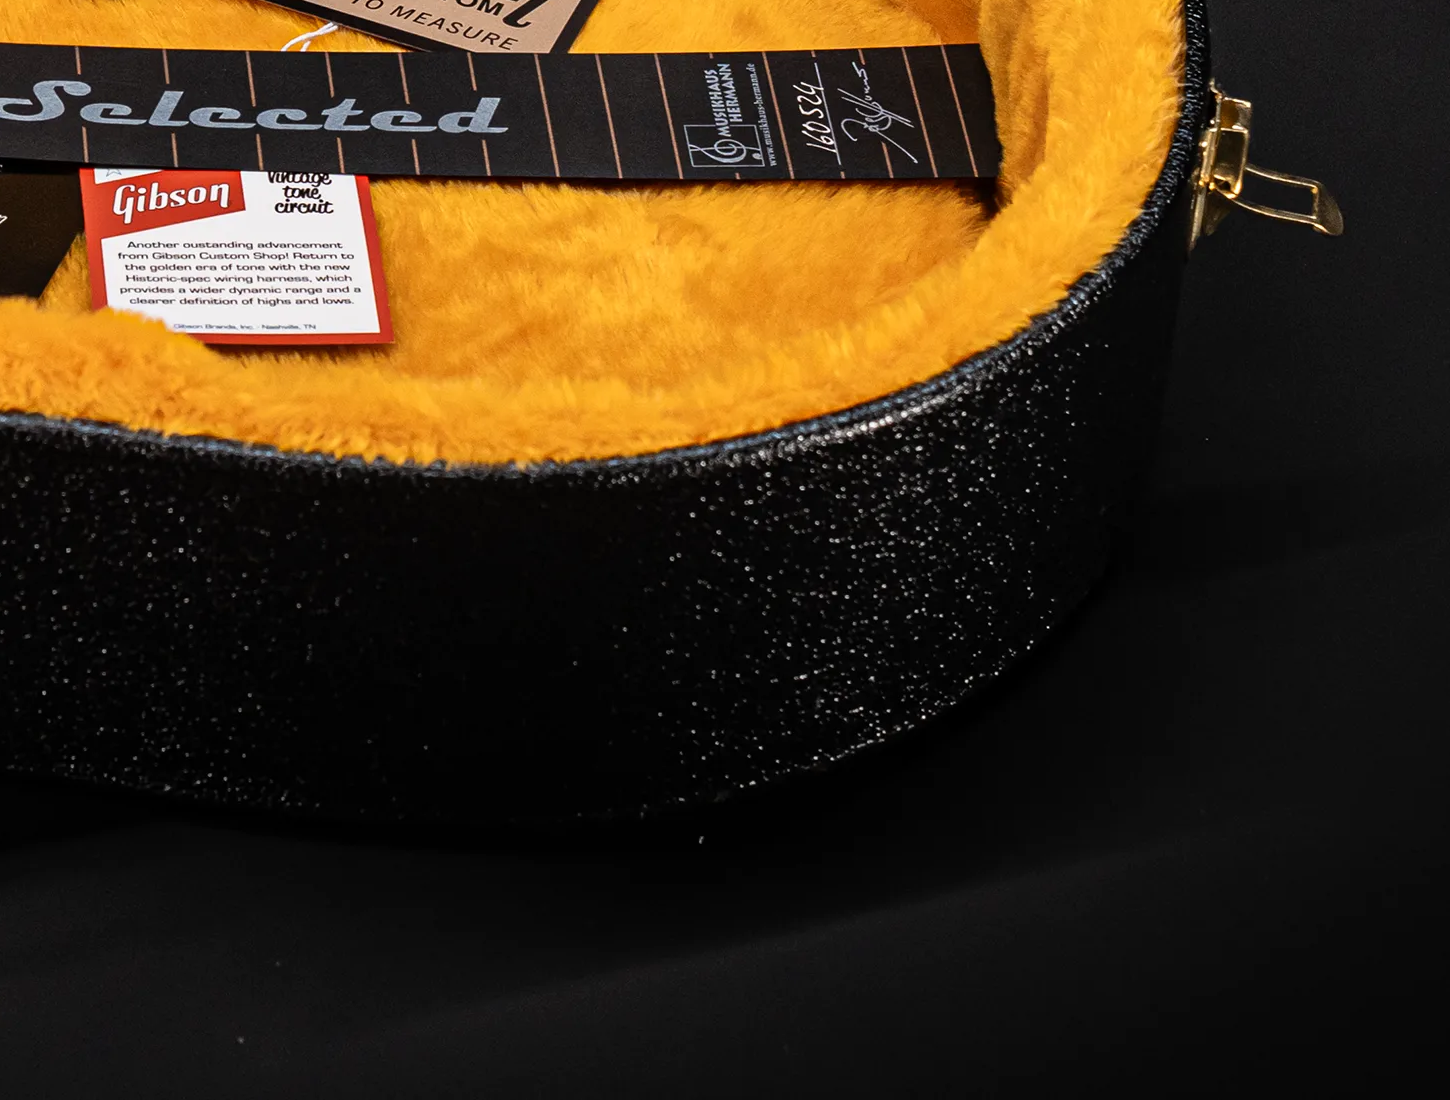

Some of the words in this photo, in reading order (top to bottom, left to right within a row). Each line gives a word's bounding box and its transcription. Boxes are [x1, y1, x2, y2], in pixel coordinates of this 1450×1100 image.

[389, 3, 520, 51] MEASURE
[717, 63, 743, 122] HERMANN
[703, 69, 732, 137] MUSIKHAUS
[745, 63, 778, 167] www.musikhaus-hermann.de
[792, 81, 839, 154] 160524
[282, 185, 322, 200] tone
[112, 182, 230, 225] Gibson
[274, 199, 334, 214] circuit
[127, 241, 180, 249] Another
[183, 241, 254, 250] oustanding
[257, 241, 343, 249] advancement
[118, 252, 149, 260] from
[152, 252, 196, 260] Gibson
[199, 252, 250, 260] Custom
[253, 252, 289, 261] Shop!
[293, 252, 338, 260] Return
[124, 263, 146, 271] the
[150, 263, 192, 273] golden
[220, 263, 233, 271] of
[268, 263, 296, 271] with
[299, 263, 321, 271] the
[125, 275, 211, 284] Historic-spec
[214, 275, 253, 284] wiring
[256, 275, 313, 283] harness,
[315, 274, 353, 282] which
[119, 286, 175, 295] provides
[189, 286, 225, 294] wider
[228, 286, 282, 295] dynamic
[285, 287, 323, 295] range
[326, 286, 350, 294] and
[129, 297, 176, 305] clearer
[179, 297, 238, 305] definition
[241, 297, 254, 305] of
[257, 297, 292, 307] highs
[295, 297, 319, 305] and
[322, 297, 355, 305] lows.
